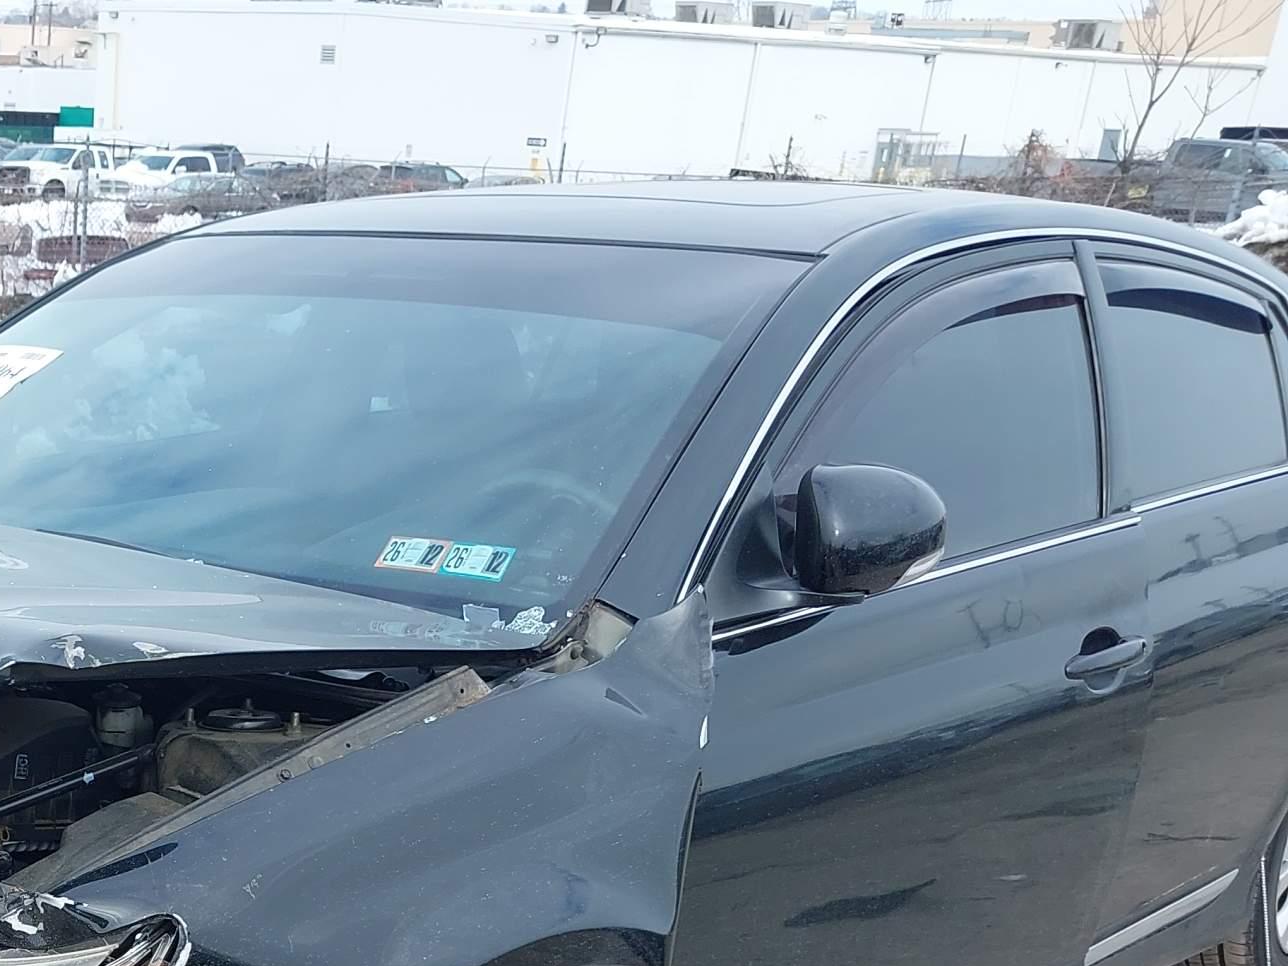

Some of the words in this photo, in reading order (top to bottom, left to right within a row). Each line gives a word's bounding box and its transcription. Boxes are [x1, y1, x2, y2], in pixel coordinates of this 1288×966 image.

[382, 540, 405, 562] 26
[420, 543, 444, 566] 12
[446, 546, 468, 569] 26
[485, 550, 509, 573] 12
